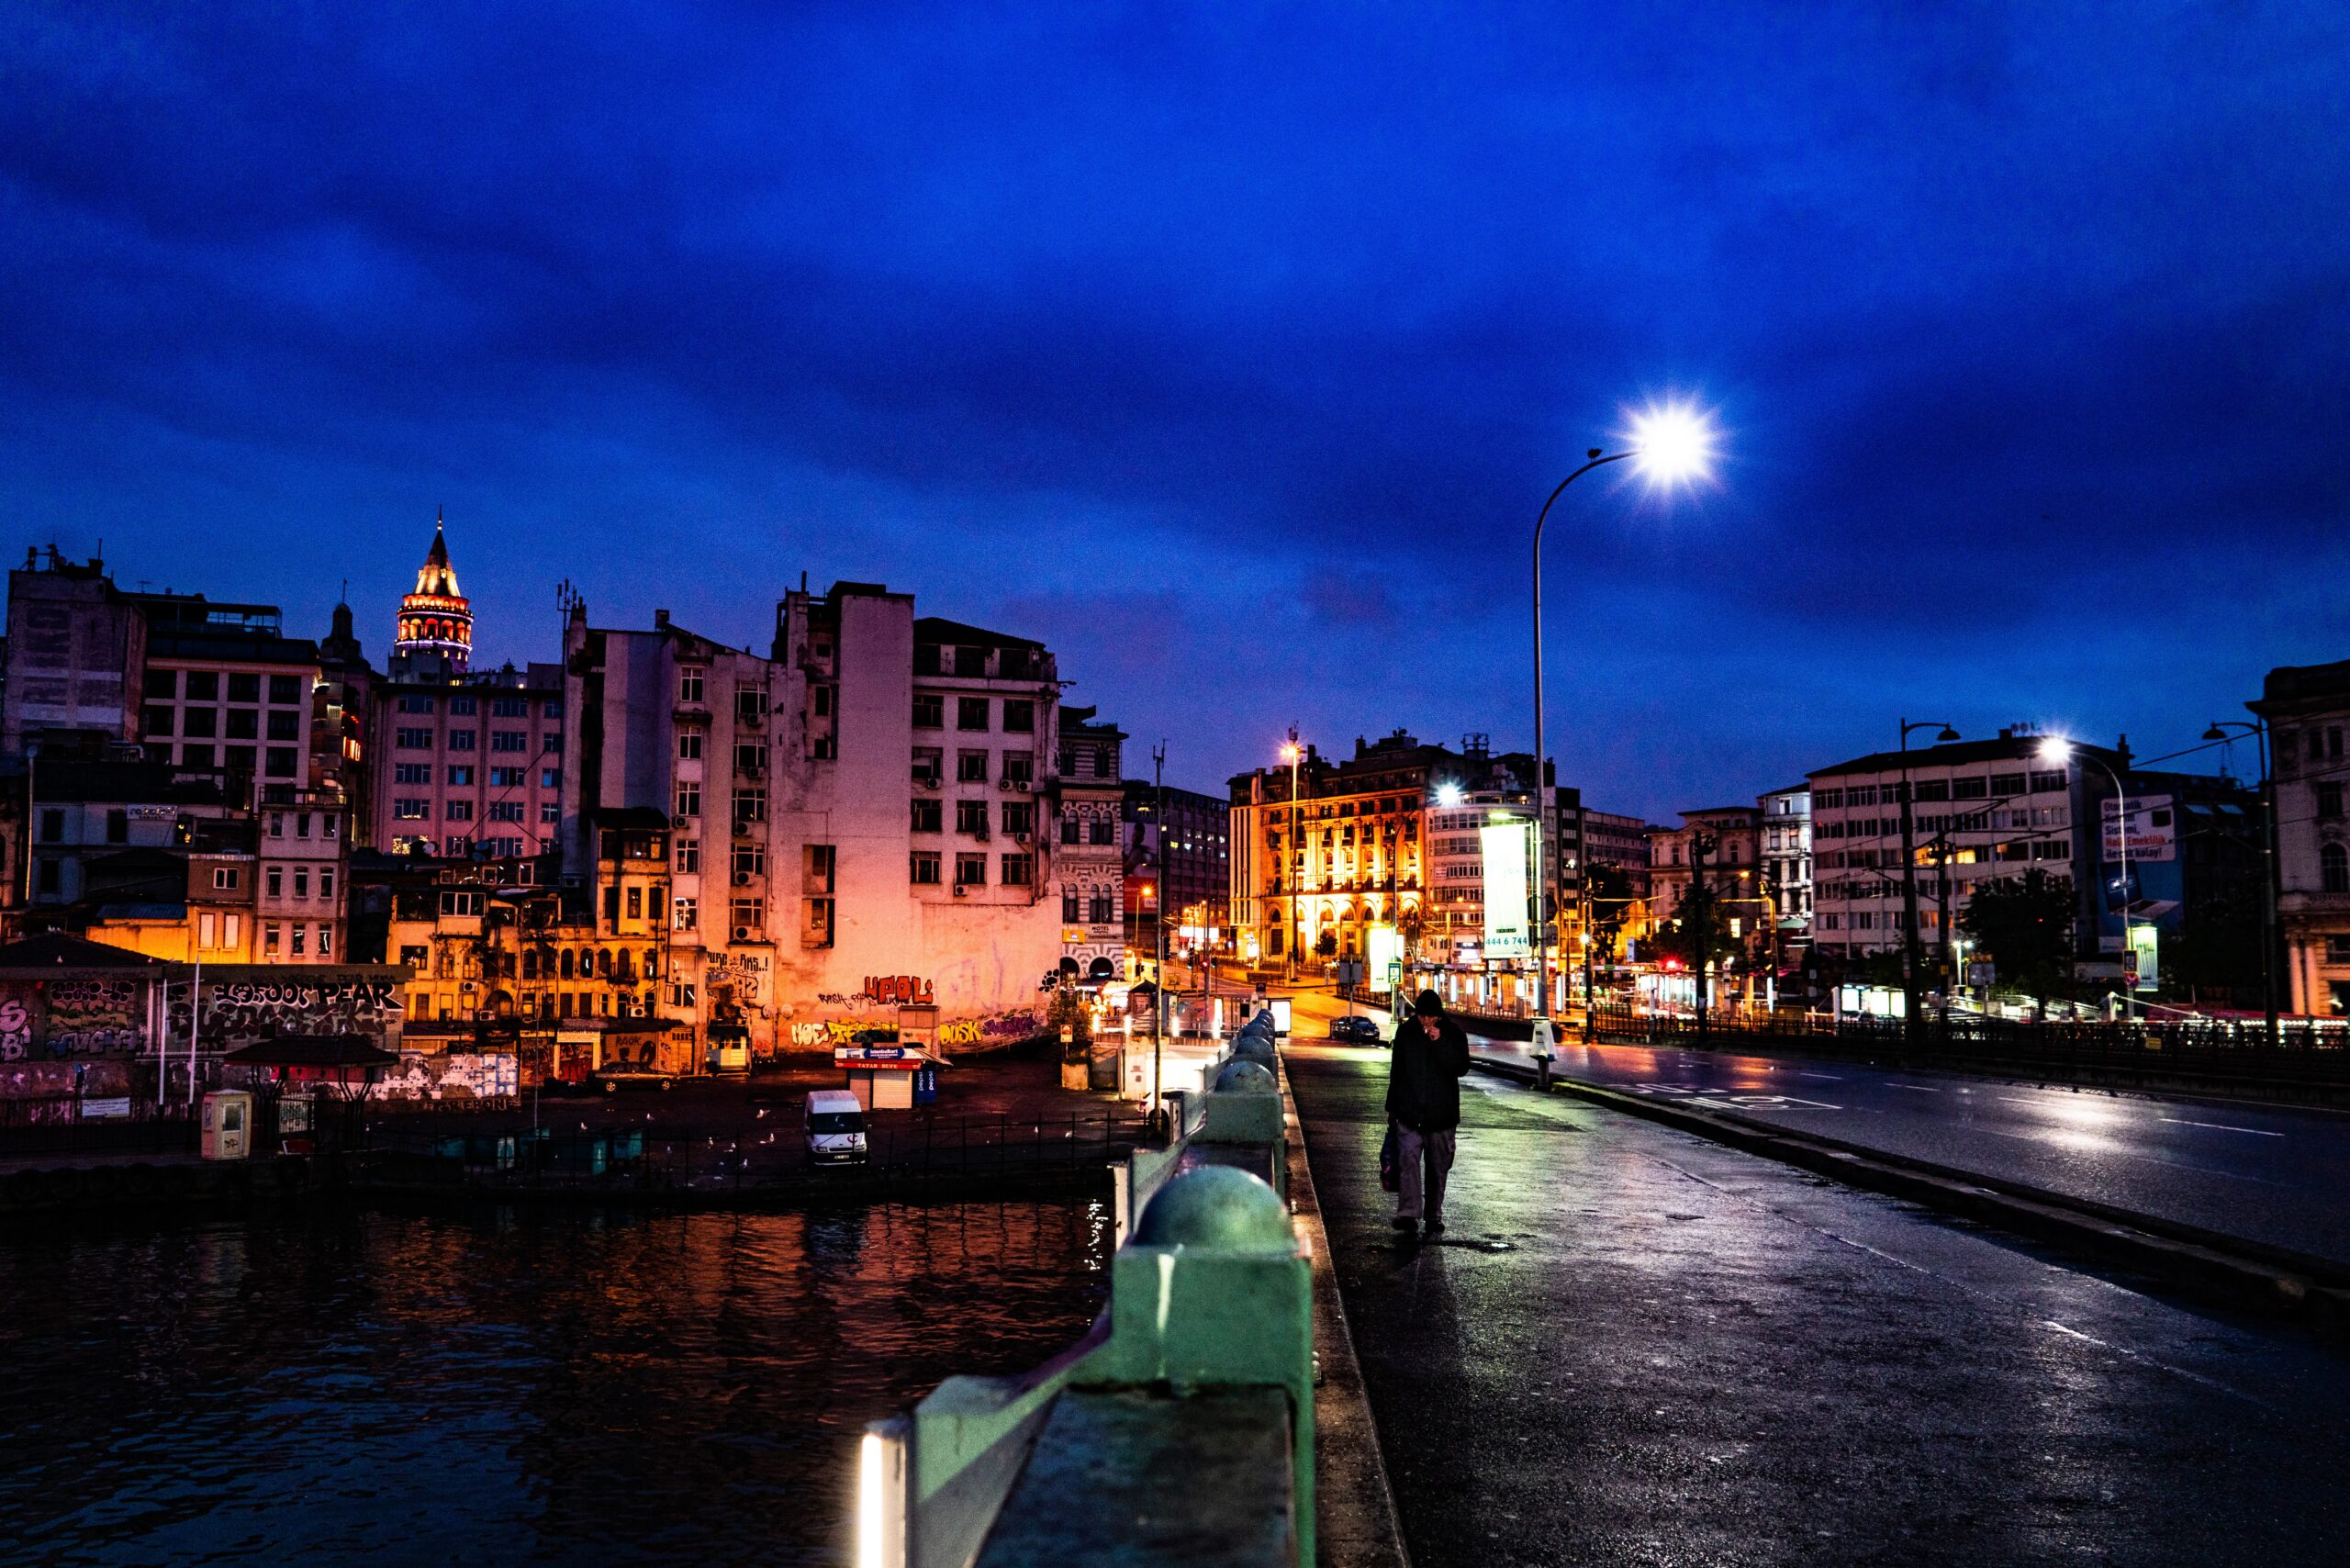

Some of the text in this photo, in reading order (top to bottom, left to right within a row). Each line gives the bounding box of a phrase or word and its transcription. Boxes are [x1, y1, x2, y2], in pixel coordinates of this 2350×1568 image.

[2104, 800, 2142, 811] Otoatik
[2106, 824, 2140, 835] Sistmi,
[1485, 937, 1501, 946] 444
[1512, 936, 1528, 945] 744
[316, 982, 404, 1012] PEAR
